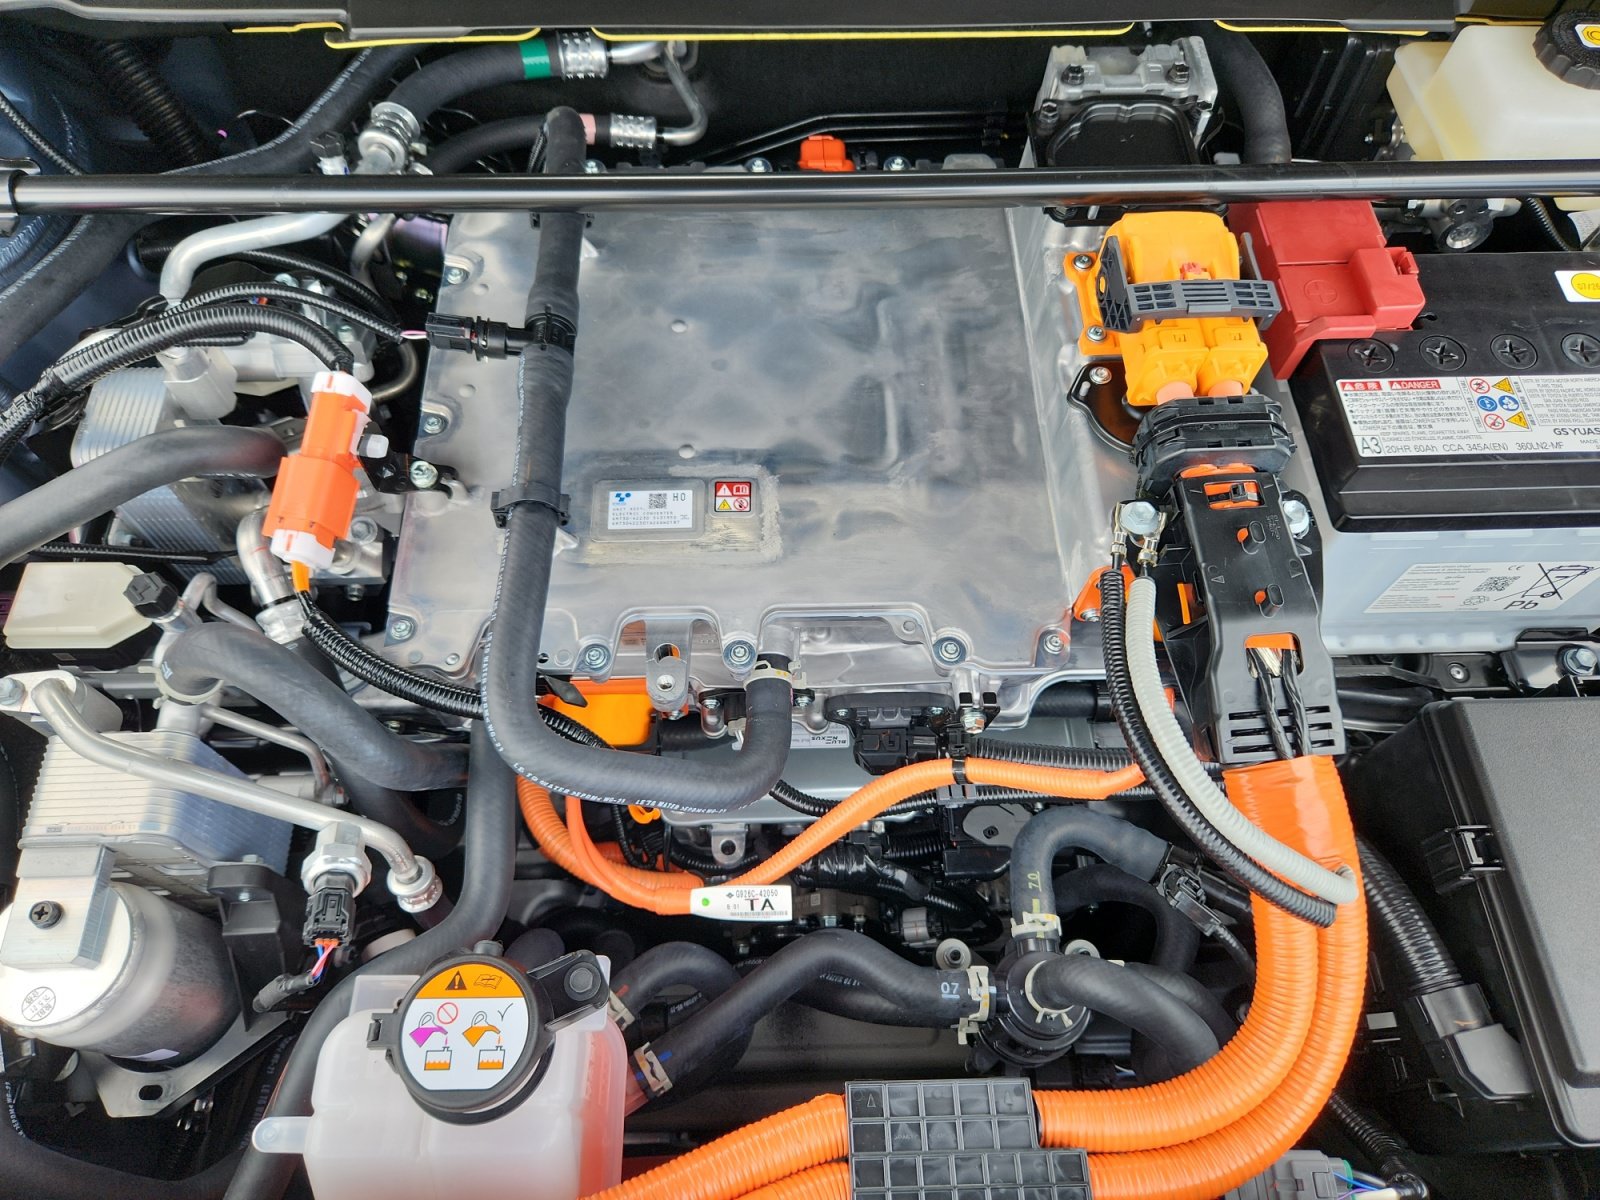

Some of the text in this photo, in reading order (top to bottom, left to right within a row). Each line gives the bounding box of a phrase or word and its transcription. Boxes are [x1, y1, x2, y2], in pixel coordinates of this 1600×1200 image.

[1400, 380, 1439, 390] DANGER
[1361, 437, 1382, 454] A3
[1386, 441, 1564, 454] 20HR 60Ah CCA 345A(EN) 360LN2-MF
[1504, 600, 1538, 610] Pb
[744, 898, 774, 911] TA
[941, 982, 959, 994] 07
